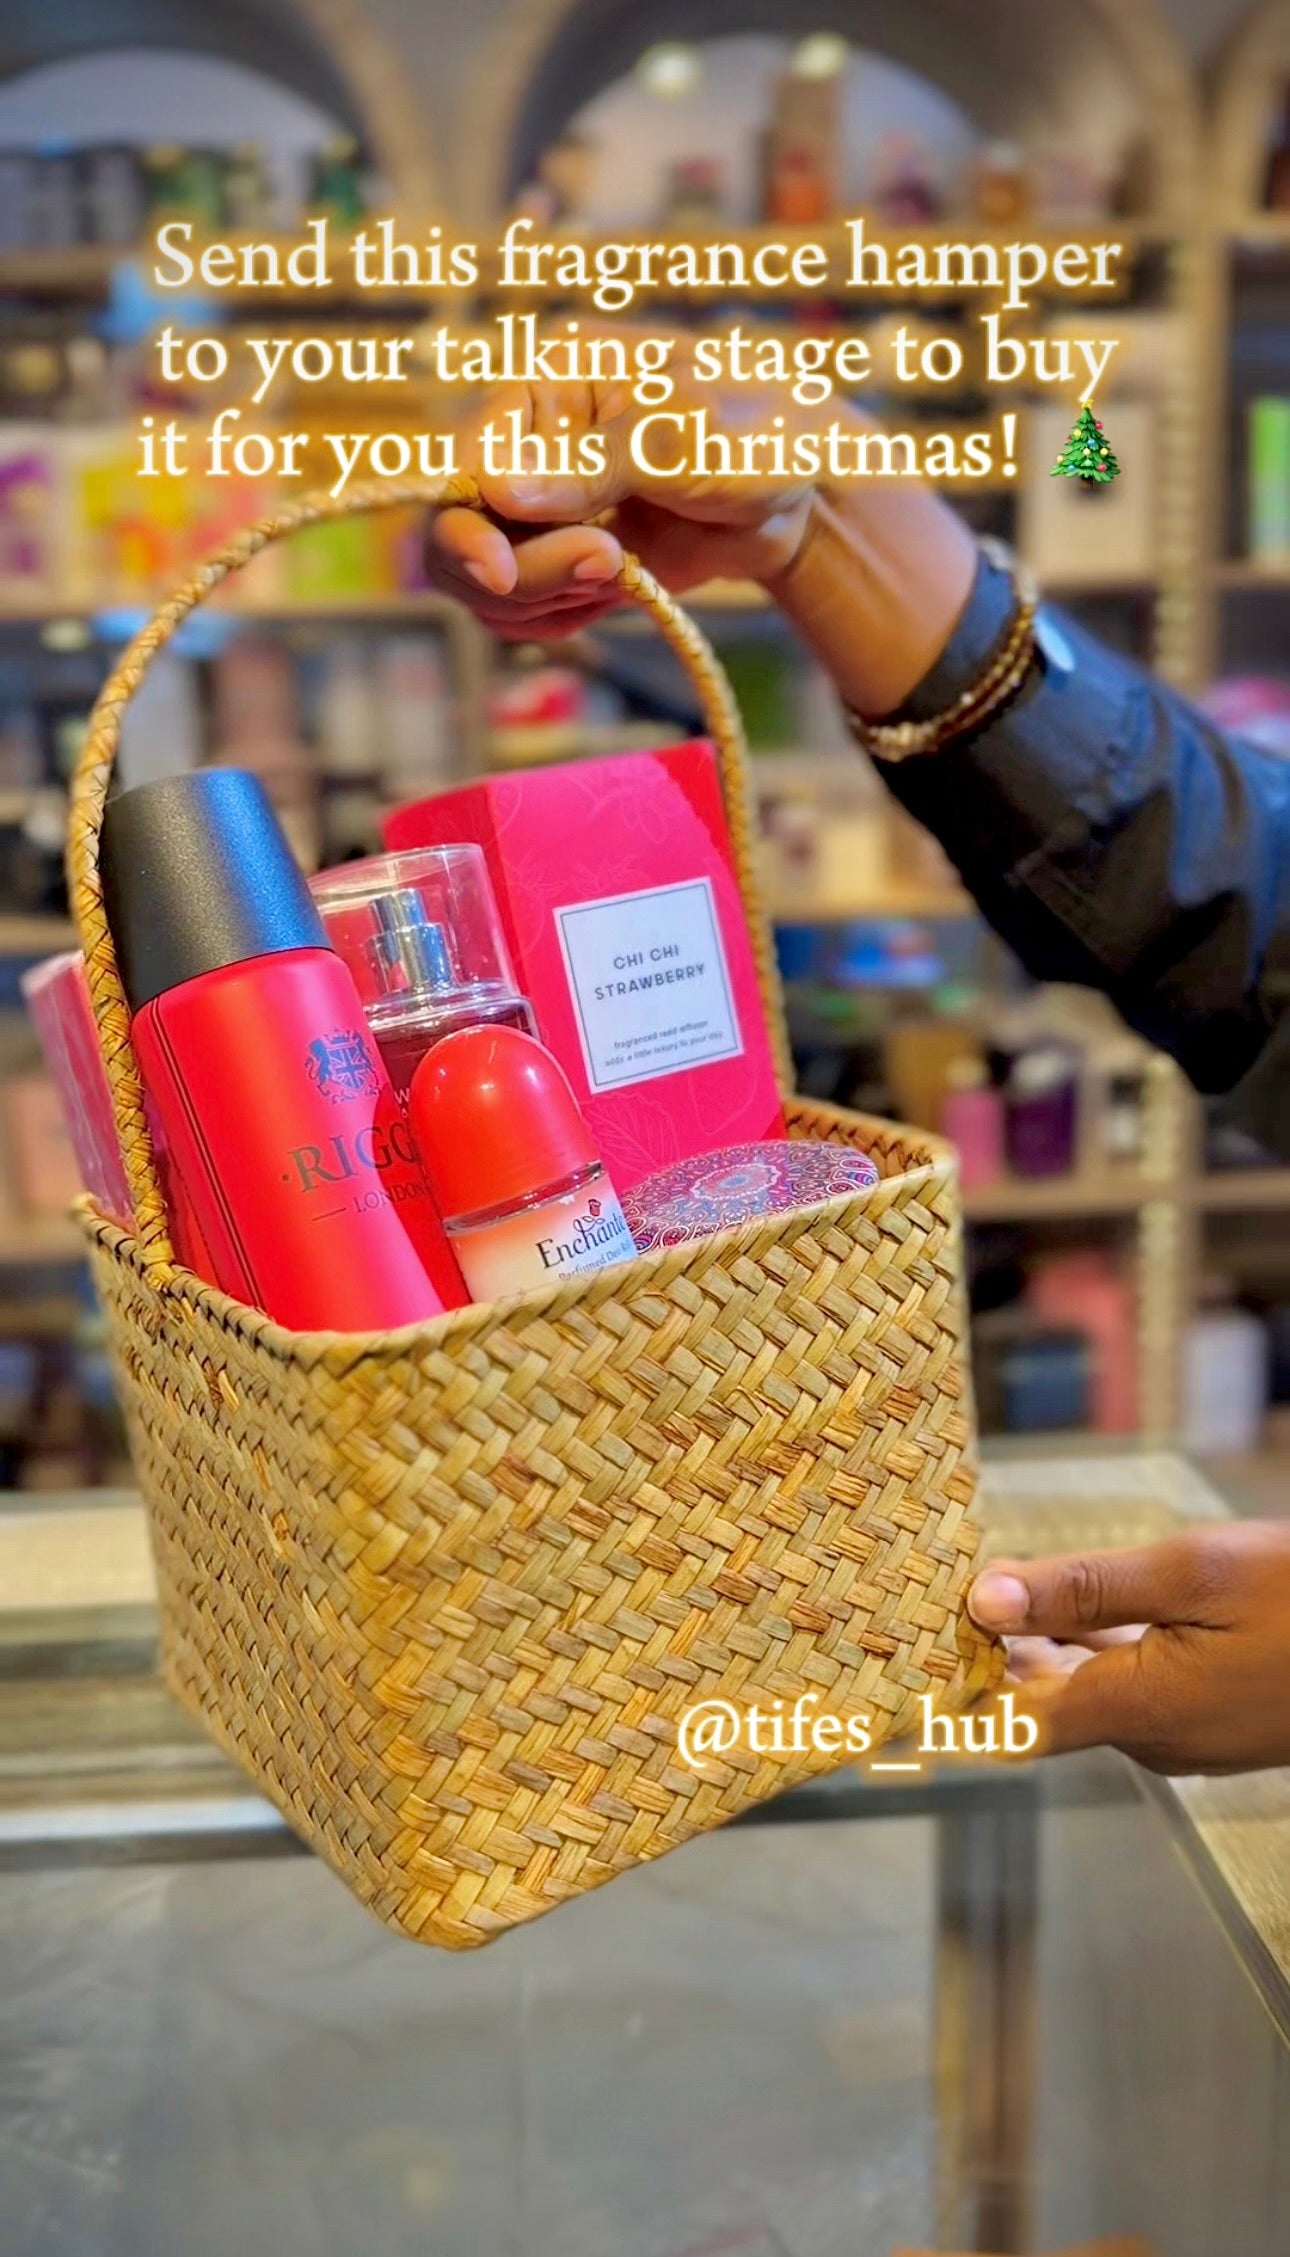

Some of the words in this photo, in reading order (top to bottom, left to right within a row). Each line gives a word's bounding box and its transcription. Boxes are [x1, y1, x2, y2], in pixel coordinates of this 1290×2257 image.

[613, 950, 644, 970] CHI
[649, 944, 680, 962] CHI
[593, 962, 706, 1001] STRAWBERRY
[353, 1179, 429, 1213] LONDON
